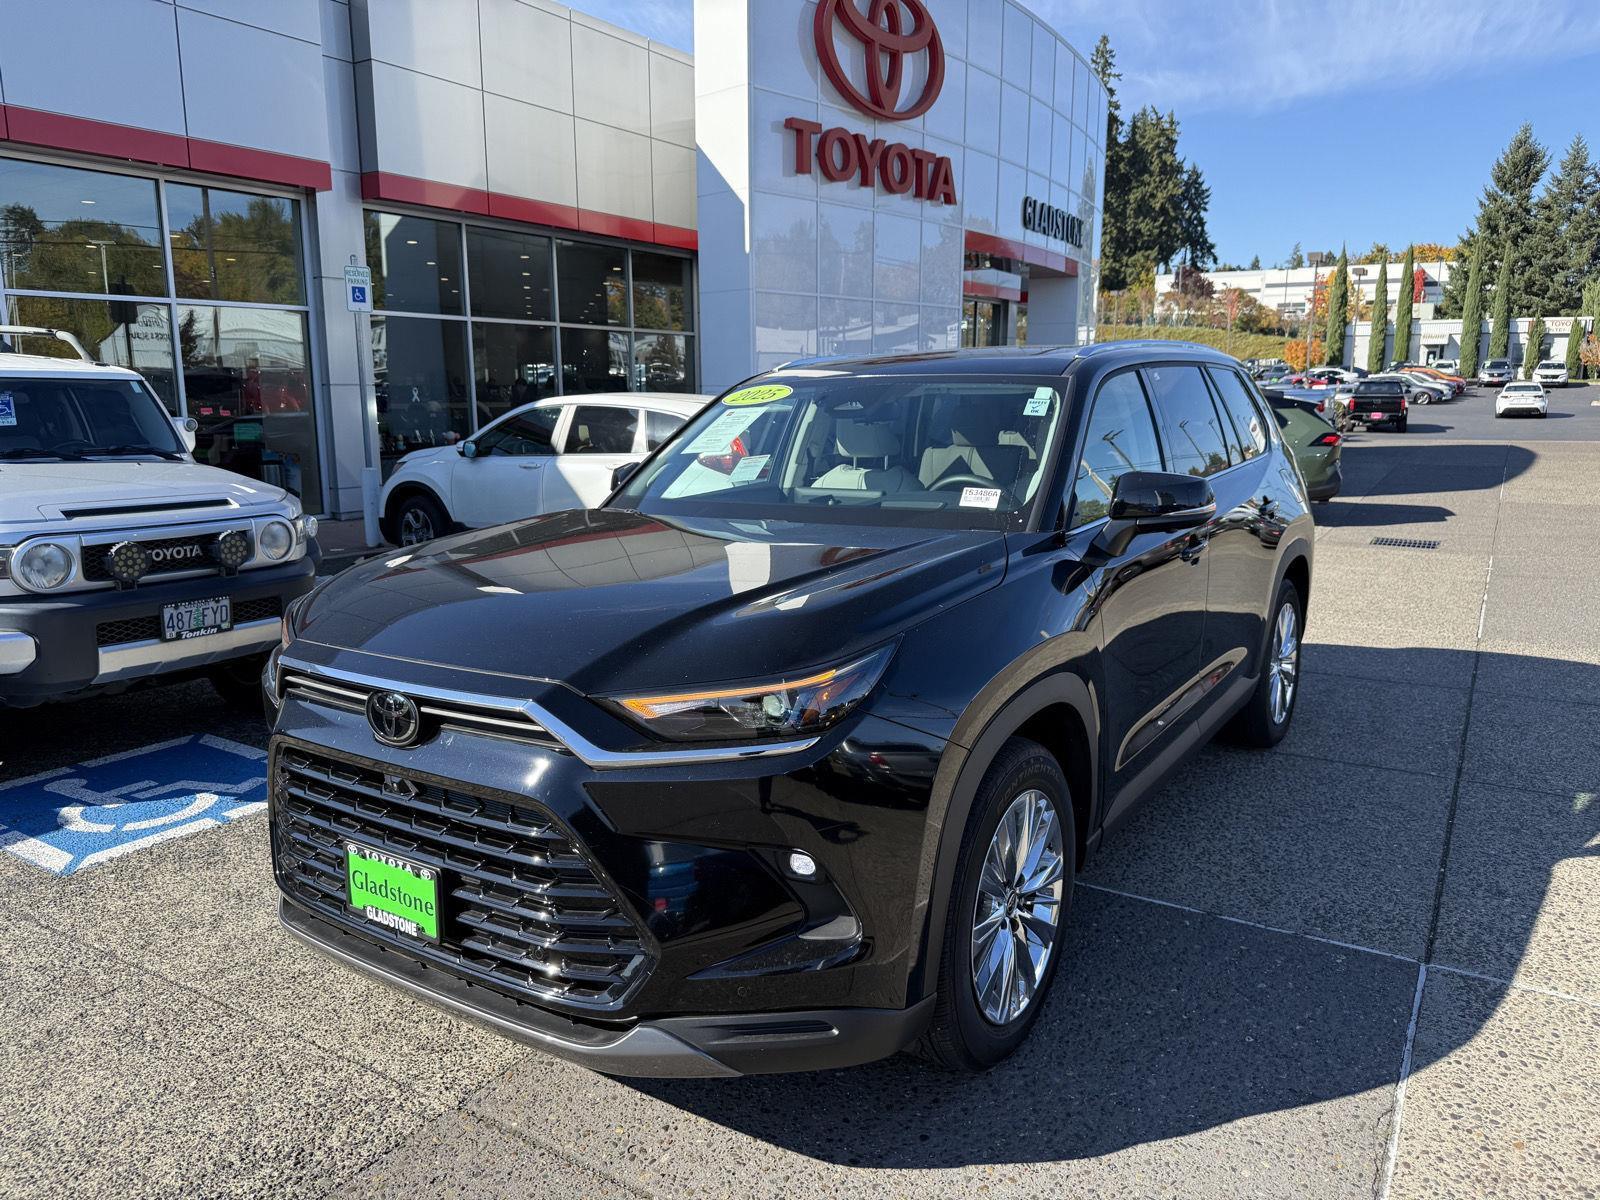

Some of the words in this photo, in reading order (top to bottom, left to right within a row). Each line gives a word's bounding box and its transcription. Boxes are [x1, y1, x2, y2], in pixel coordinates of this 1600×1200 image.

[784, 117, 957, 205] TOYOTA
[345, 270, 369, 278] RESERVED
[347, 278, 369, 286] PARKING
[729, 388, 785, 402] 2025
[166, 609, 194, 632] 487
[202, 604, 229, 626] FYD
[181, 627, 218, 639] Tonkin
[364, 849, 413, 873] TOYOTA
[352, 869, 434, 917] Gladstone
[366, 905, 418, 937] GLADSTONE
